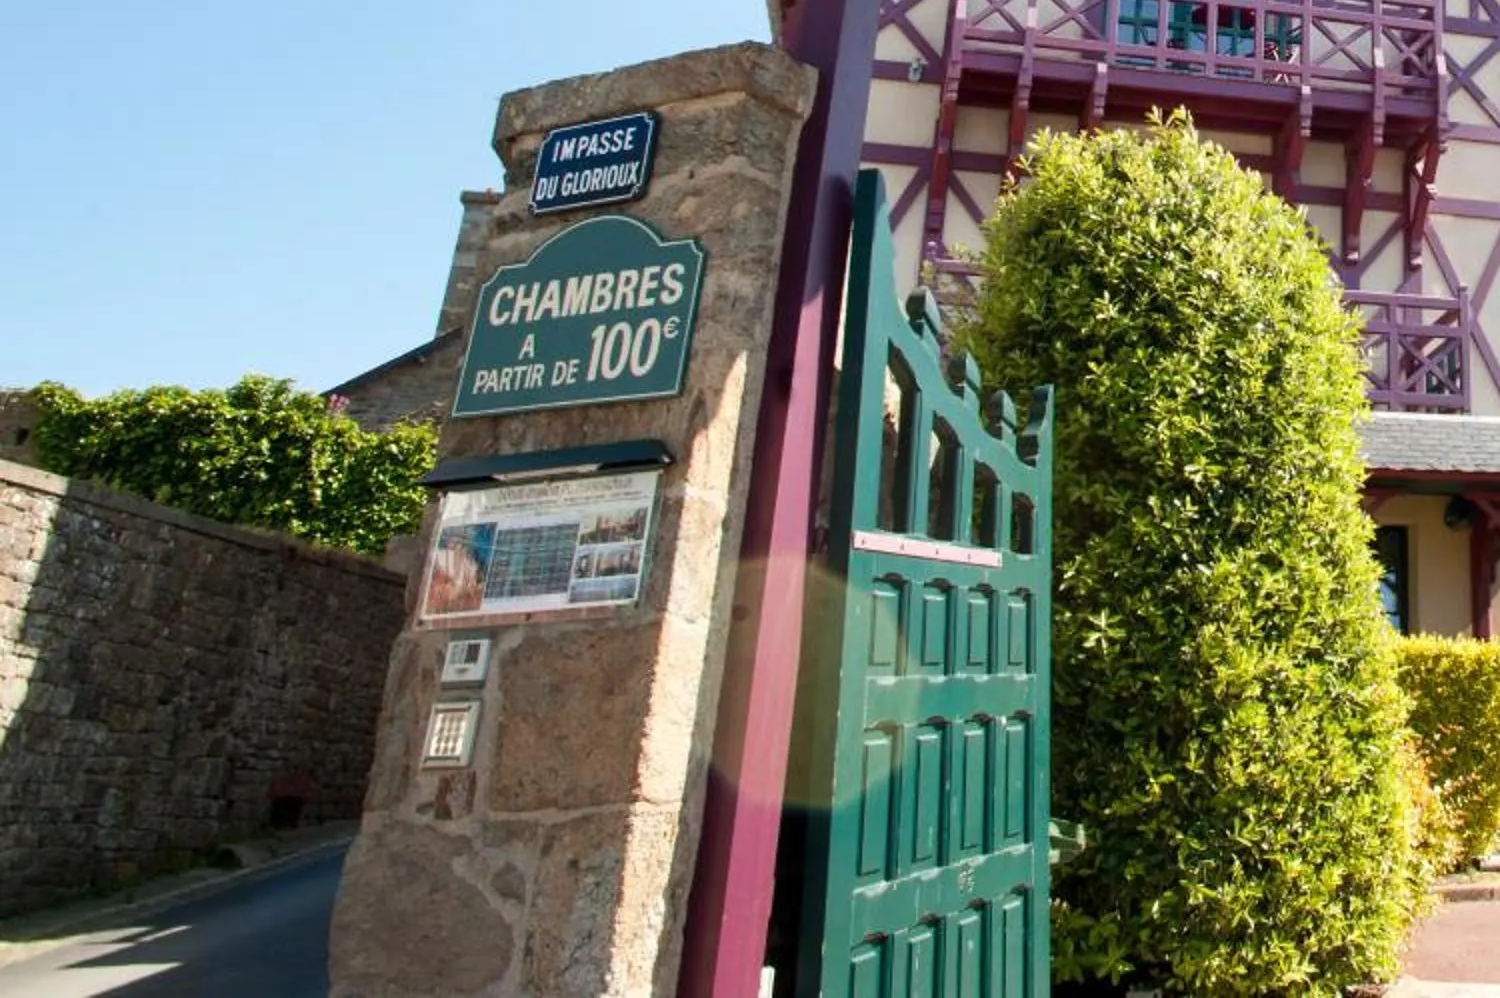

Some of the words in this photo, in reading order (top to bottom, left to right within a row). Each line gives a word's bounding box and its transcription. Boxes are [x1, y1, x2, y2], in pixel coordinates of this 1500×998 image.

[551, 127, 637, 163] IMPASSE
[535, 176, 558, 201] DU
[560, 161, 640, 197] GLORIOUX
[488, 263, 686, 327] CHAMBRES
[519, 333, 535, 360] A
[473, 363, 545, 395] PARTIR
[551, 358, 580, 385] DE
